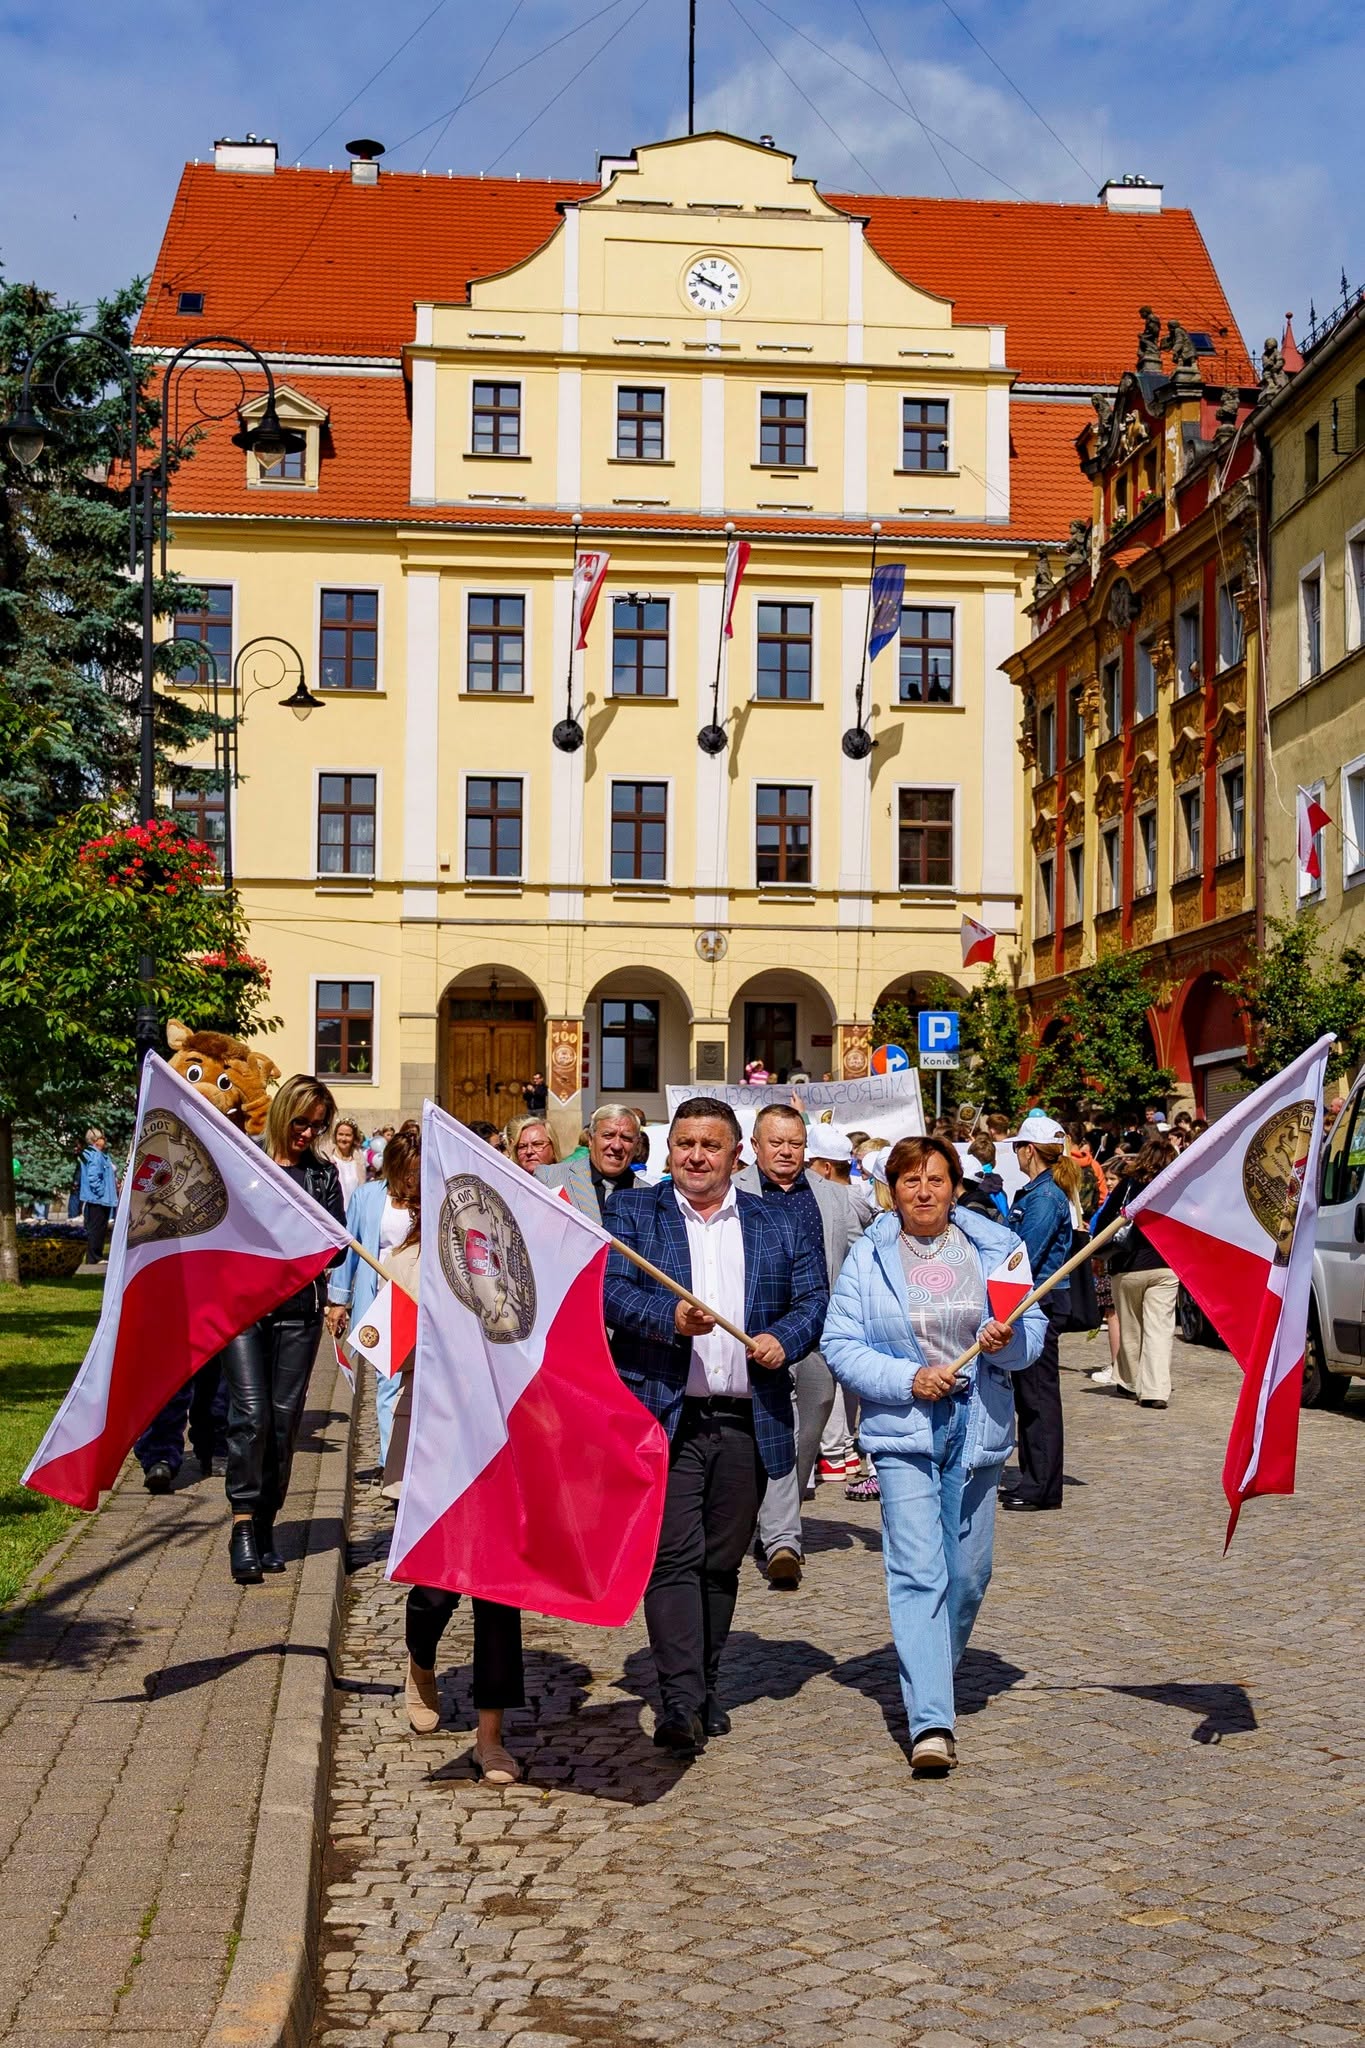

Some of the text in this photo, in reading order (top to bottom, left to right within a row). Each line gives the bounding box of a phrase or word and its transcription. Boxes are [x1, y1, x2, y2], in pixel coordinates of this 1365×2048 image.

[552, 1031, 578, 1044] 700
[928, 1016, 951, 1048] P
[923, 1056, 958, 1066] Koniec
